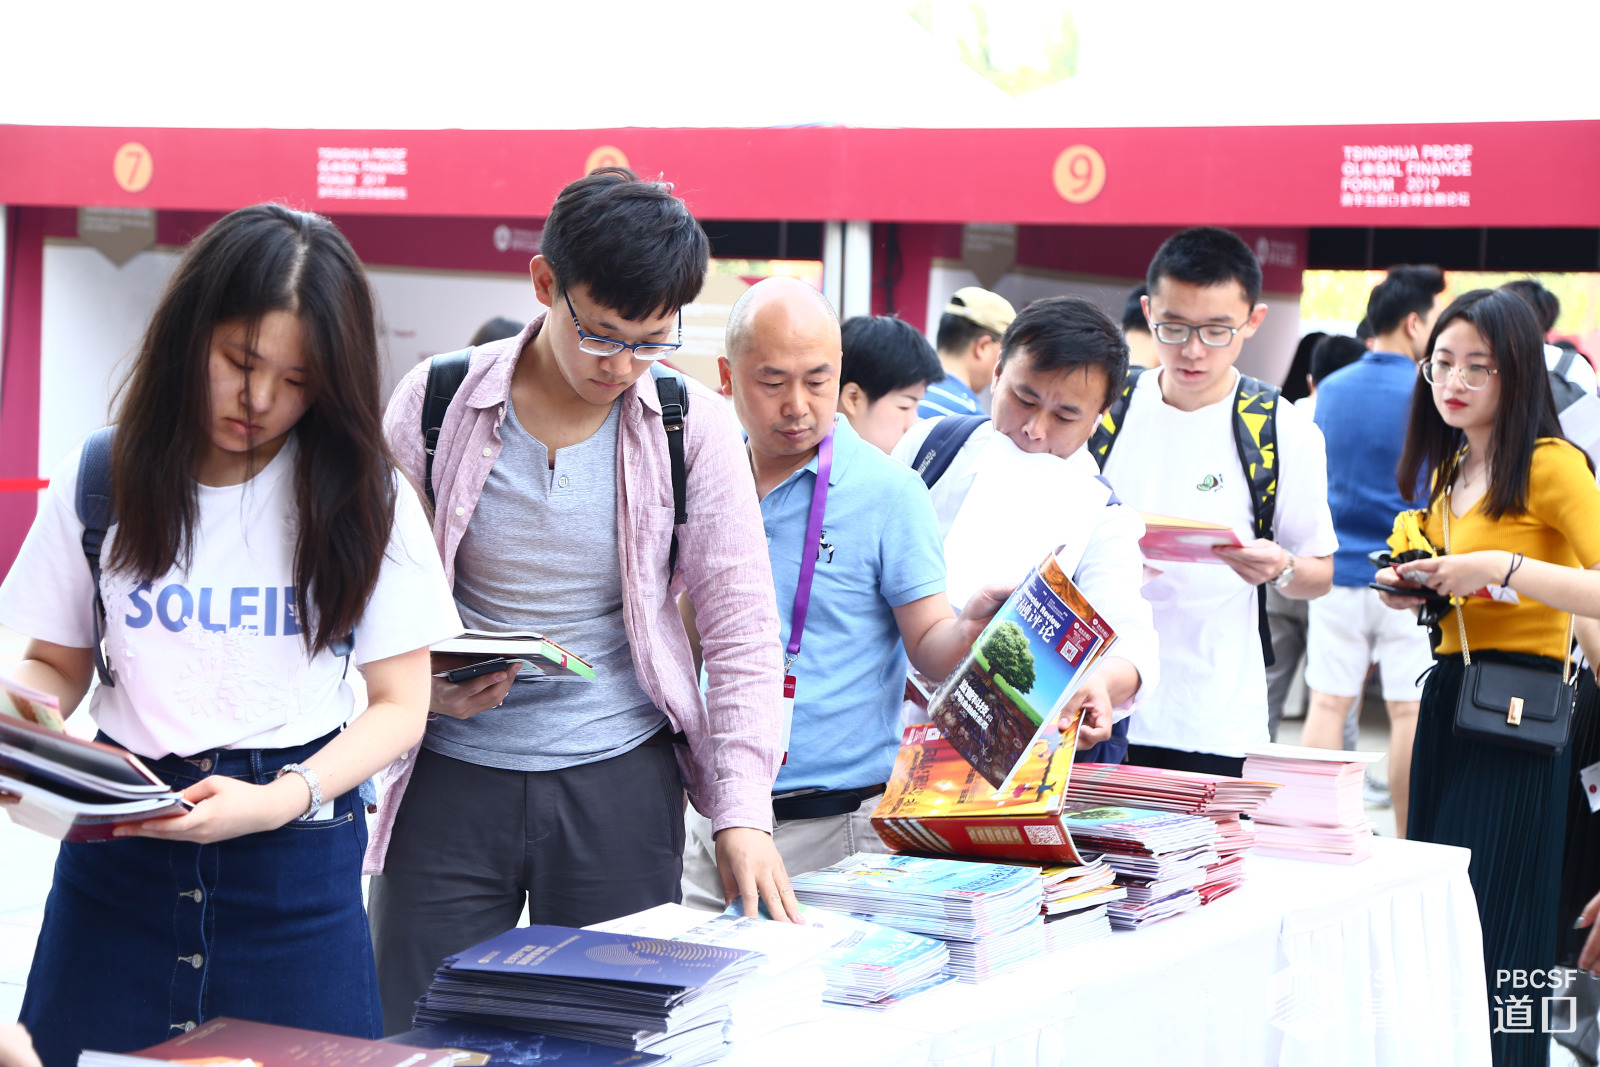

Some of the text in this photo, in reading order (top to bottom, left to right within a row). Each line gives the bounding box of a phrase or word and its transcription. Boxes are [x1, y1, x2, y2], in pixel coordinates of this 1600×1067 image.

[1342, 144, 1473, 161] TSINGHUA PBCSF
[124, 151, 142, 186] 7
[1070, 153, 1094, 196] 9
[1341, 160, 1472, 177] GLOBAL FINANCE
[1341, 176, 1440, 192] FORUM 2019
[1040, 605, 1061, 629] Review
